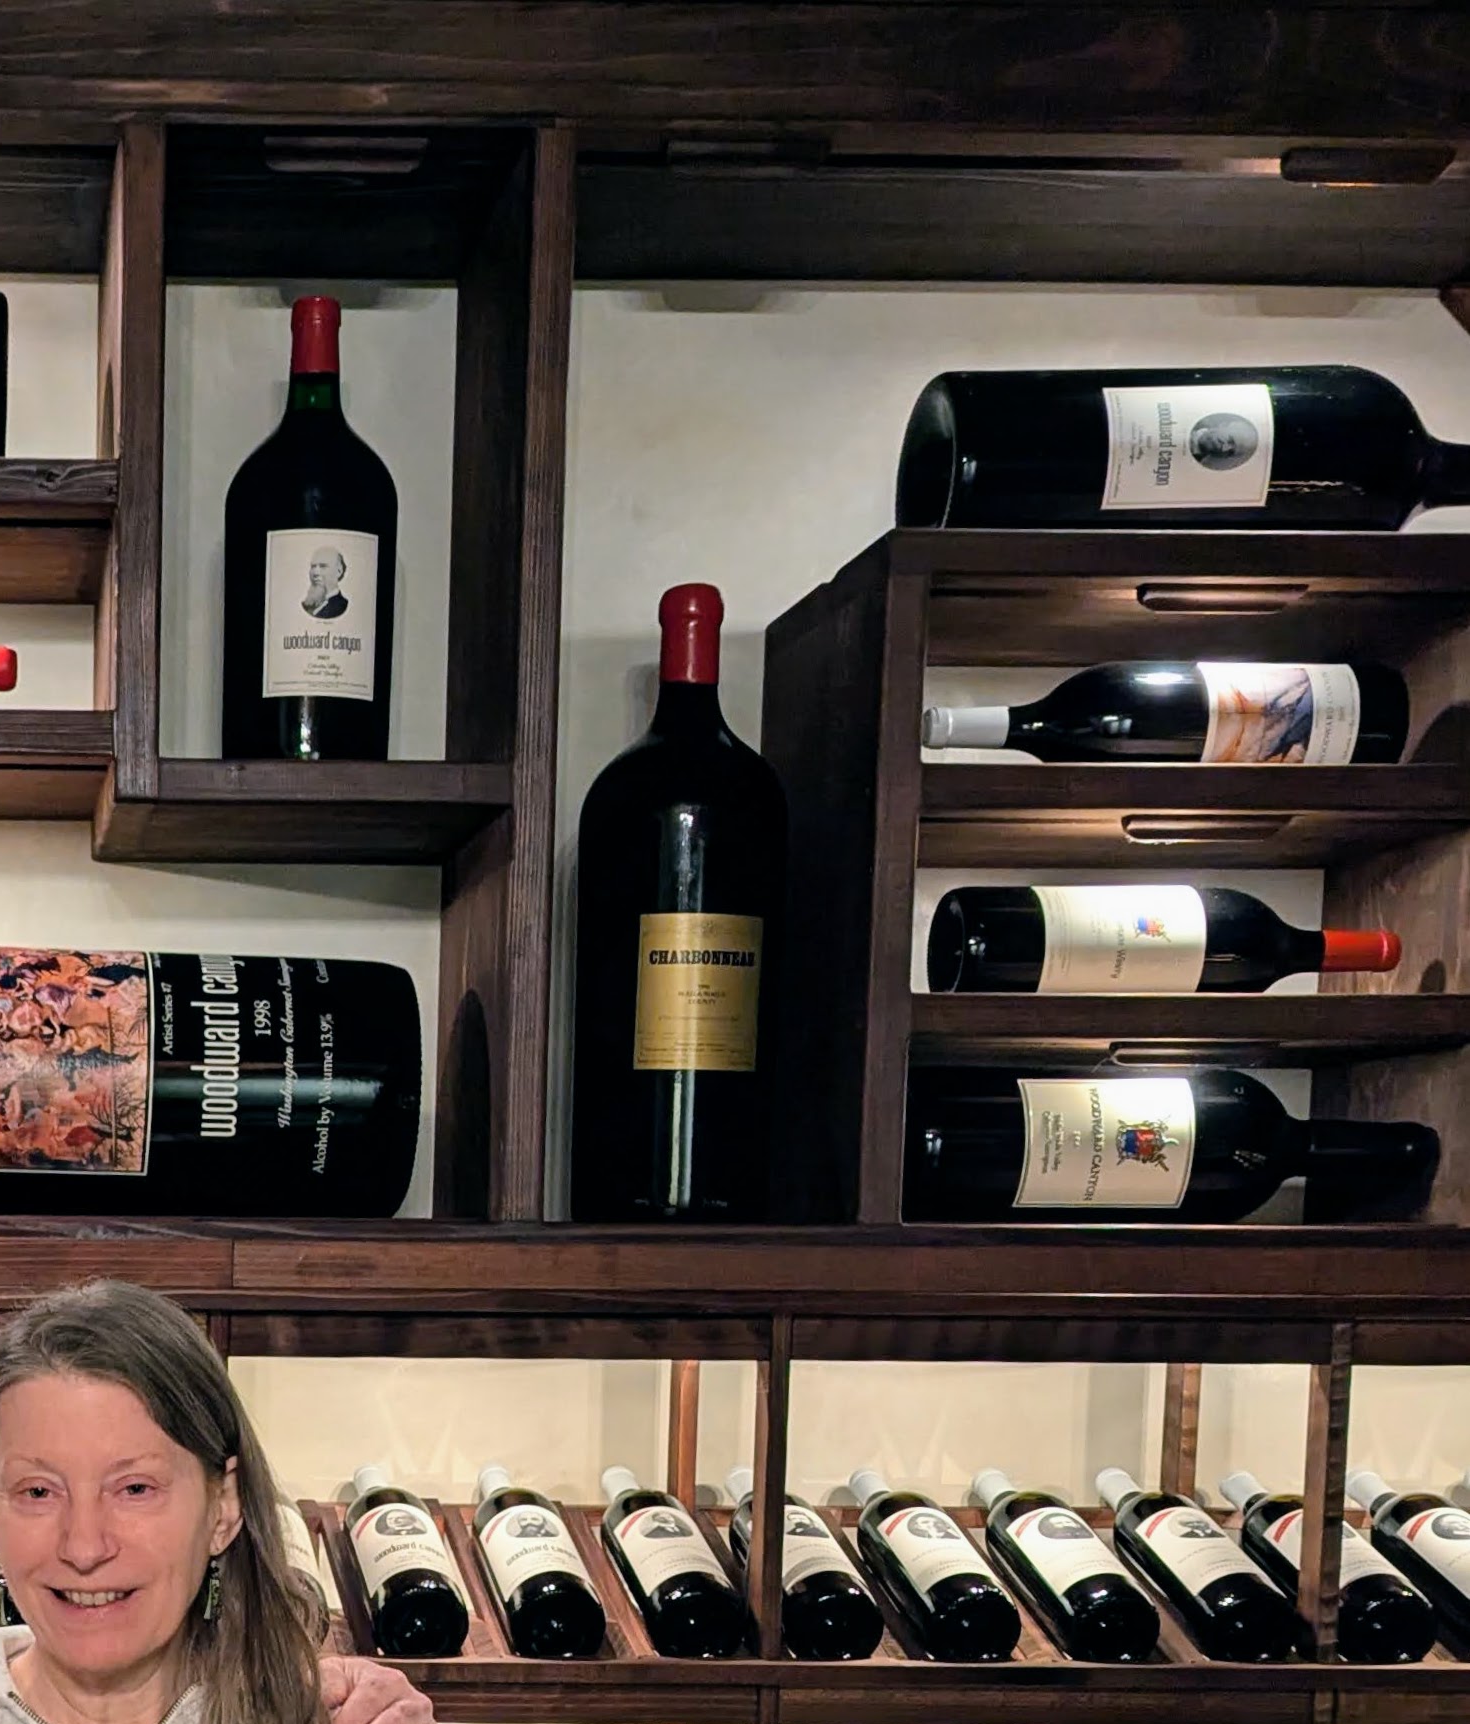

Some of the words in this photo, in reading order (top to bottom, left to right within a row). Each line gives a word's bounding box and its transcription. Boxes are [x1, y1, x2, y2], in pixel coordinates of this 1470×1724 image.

[1153, 450, 1172, 486] canyon
[283, 630, 330, 650] woodward
[332, 635, 361, 655] canyon
[649, 950, 755, 967] CHARBONNEAU
[162, 995, 172, 1023] Series
[254, 999, 272, 1037] 1998
[280, 991, 294, 1043] Cabernet
[163, 1024, 174, 1055] Artist
[320, 1013, 334, 1048] 13.9%
[190, 1001, 240, 1137] woodward
[277, 1046, 298, 1128] Washington
[318, 1107, 335, 1124] by
[312, 1126, 328, 1174] Alcohol
[1083, 1155, 1102, 1201] CANYON
